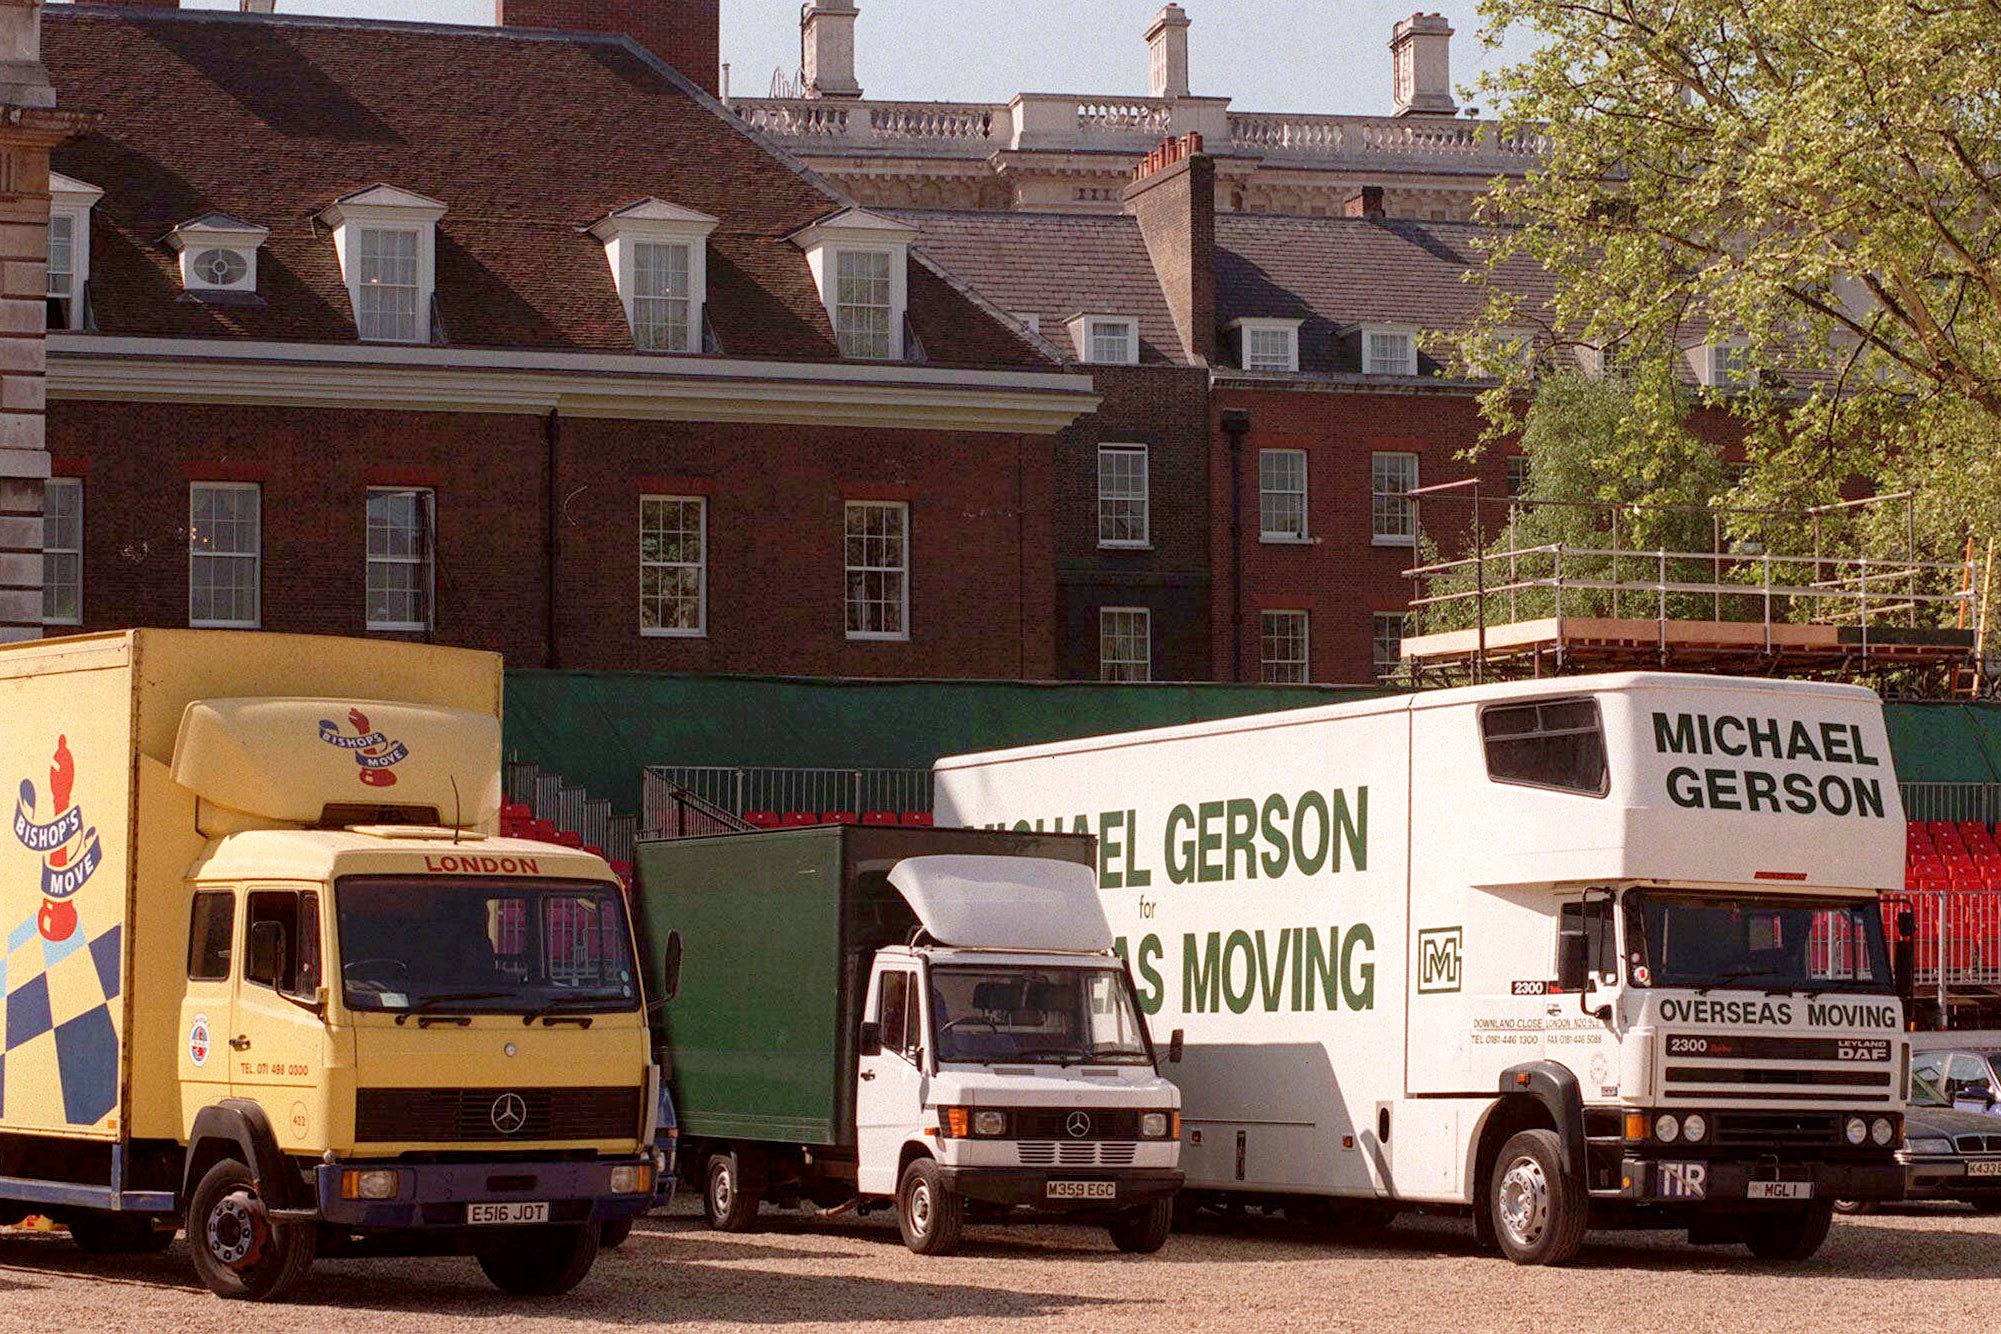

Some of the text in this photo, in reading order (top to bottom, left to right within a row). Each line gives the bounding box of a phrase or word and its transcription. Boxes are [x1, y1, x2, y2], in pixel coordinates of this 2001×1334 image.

[1652, 712, 1879, 766] MICHAEL
[367, 750, 402, 767] MOVE
[1666, 767, 1885, 818] GERSON
[15, 809, 79, 848] BISHOP'S
[1165, 785, 1369, 885] GERSON
[424, 856, 540, 874] LONDON
[50, 854, 94, 894] MOVE
[1139, 894, 1157, 919] for
[1182, 923, 1376, 1014] MOVING
[1514, 982, 1544, 994] 2300
[1659, 999, 1896, 1028] OVERSEAS MOVING
[1474, 1018, 1515, 1028] DOWNLAND
[1517, 1018, 1543, 1028] CLOSE
[1519, 1035, 1539, 1044] 1300
[1671, 1038, 1707, 1052] 2300
[1838, 1040, 1887, 1048] LEYLAND
[1838, 1048, 1888, 1060] DAF
[1658, 1163, 1706, 1197] TIR
[1048, 1183, 1114, 1196] M359 EGC
[1764, 1184, 1790, 1197] MGL
[472, 1204, 544, 1221] E516 JOT
